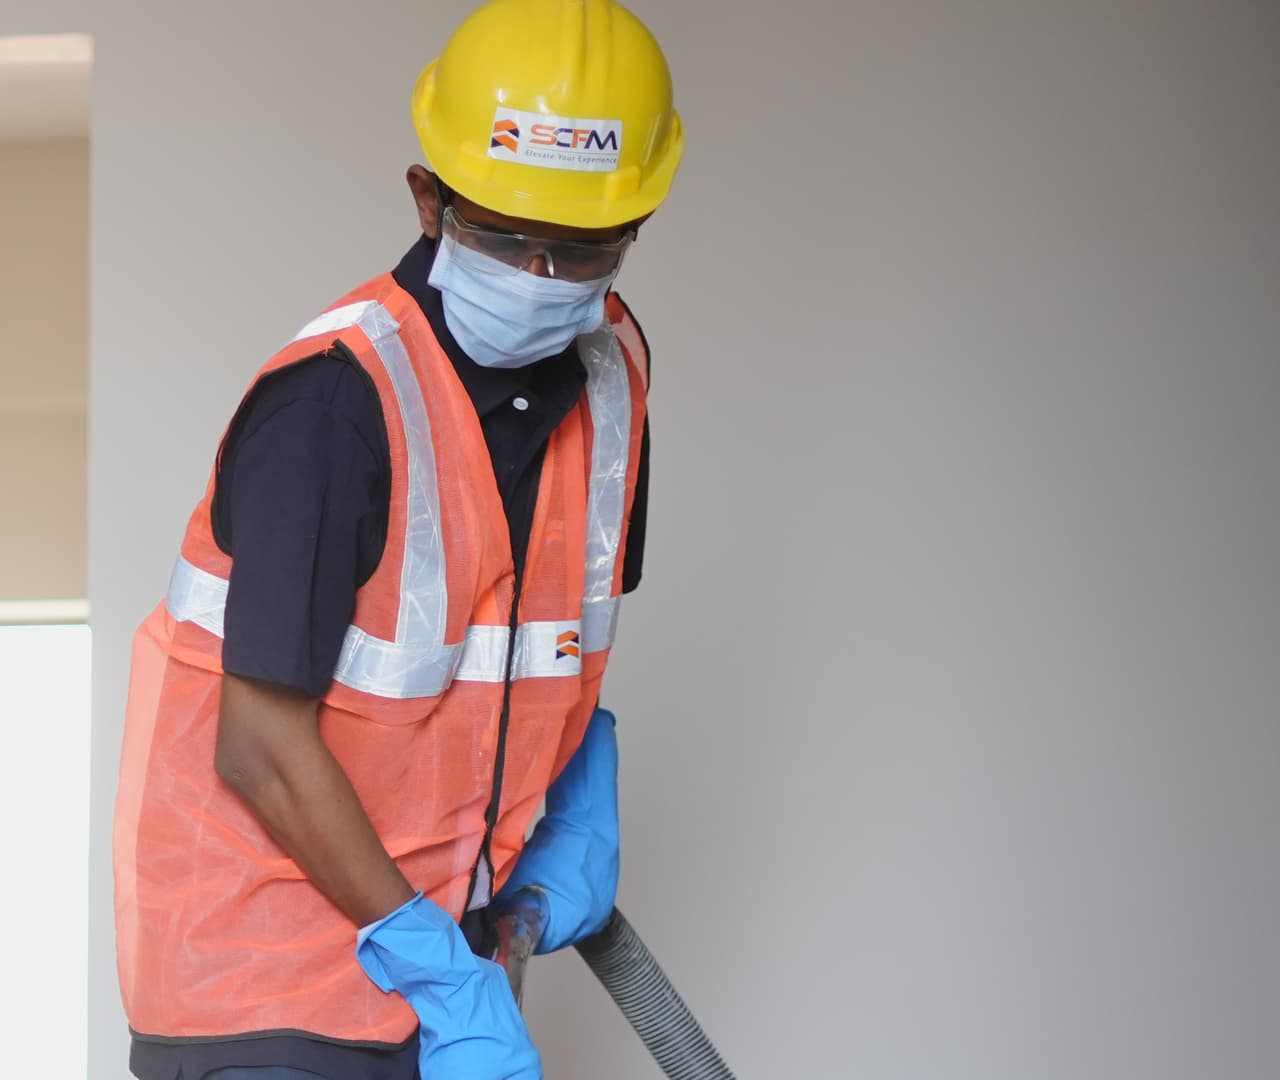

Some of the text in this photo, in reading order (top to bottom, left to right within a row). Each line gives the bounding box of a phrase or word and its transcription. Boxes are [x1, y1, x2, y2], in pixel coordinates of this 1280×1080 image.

[529, 124, 618, 150] SCFM
[525, 149, 555, 160] Elevate
[577, 155, 618, 164] Experience
